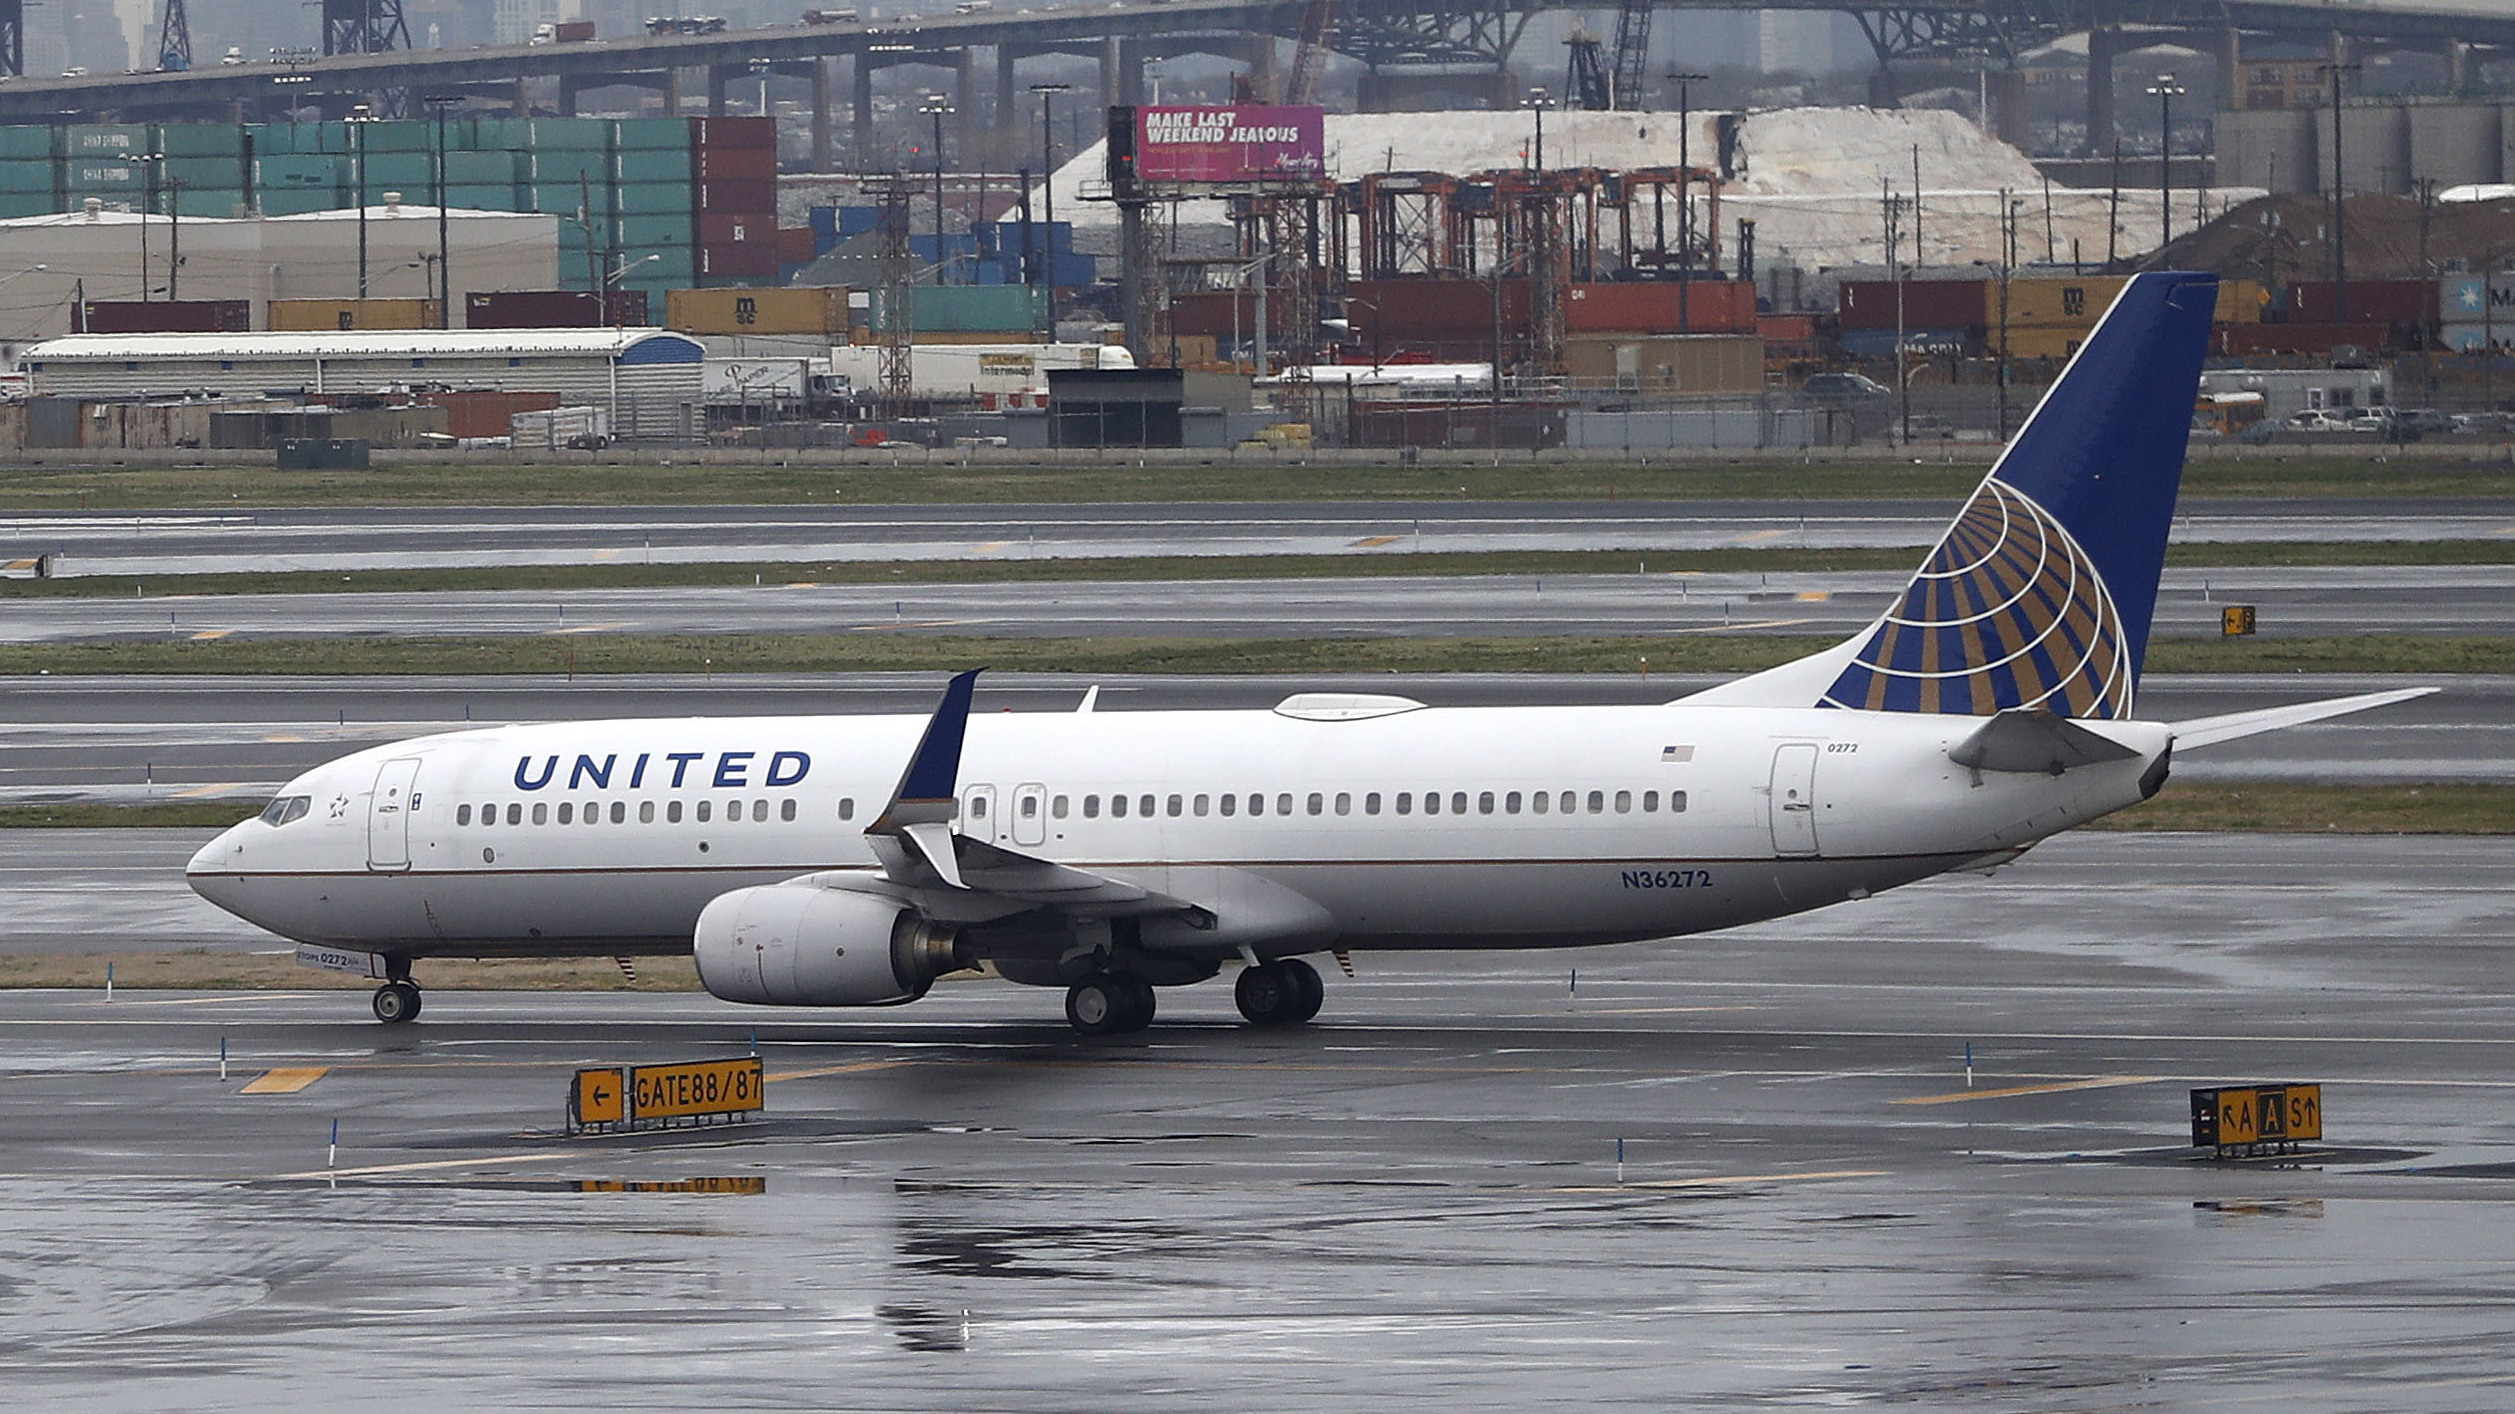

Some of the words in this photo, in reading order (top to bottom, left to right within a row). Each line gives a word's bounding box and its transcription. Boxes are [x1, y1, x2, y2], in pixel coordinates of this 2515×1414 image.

[1147, 112, 1193, 127] MAKE
[1198, 111, 1236, 127] LAST
[1147, 127, 1225, 144] WEEKEND
[1827, 743, 1859, 754] 0272
[513, 750, 812, 792] UNITED
[1621, 870, 1714, 890] N36272
[320, 952, 348, 967] 0272
[636, 1068, 762, 1109] GATE88/87
[2239, 1100, 2253, 1133] A
[2265, 1098, 2279, 1132] A
[2291, 1096, 2303, 1128] S
